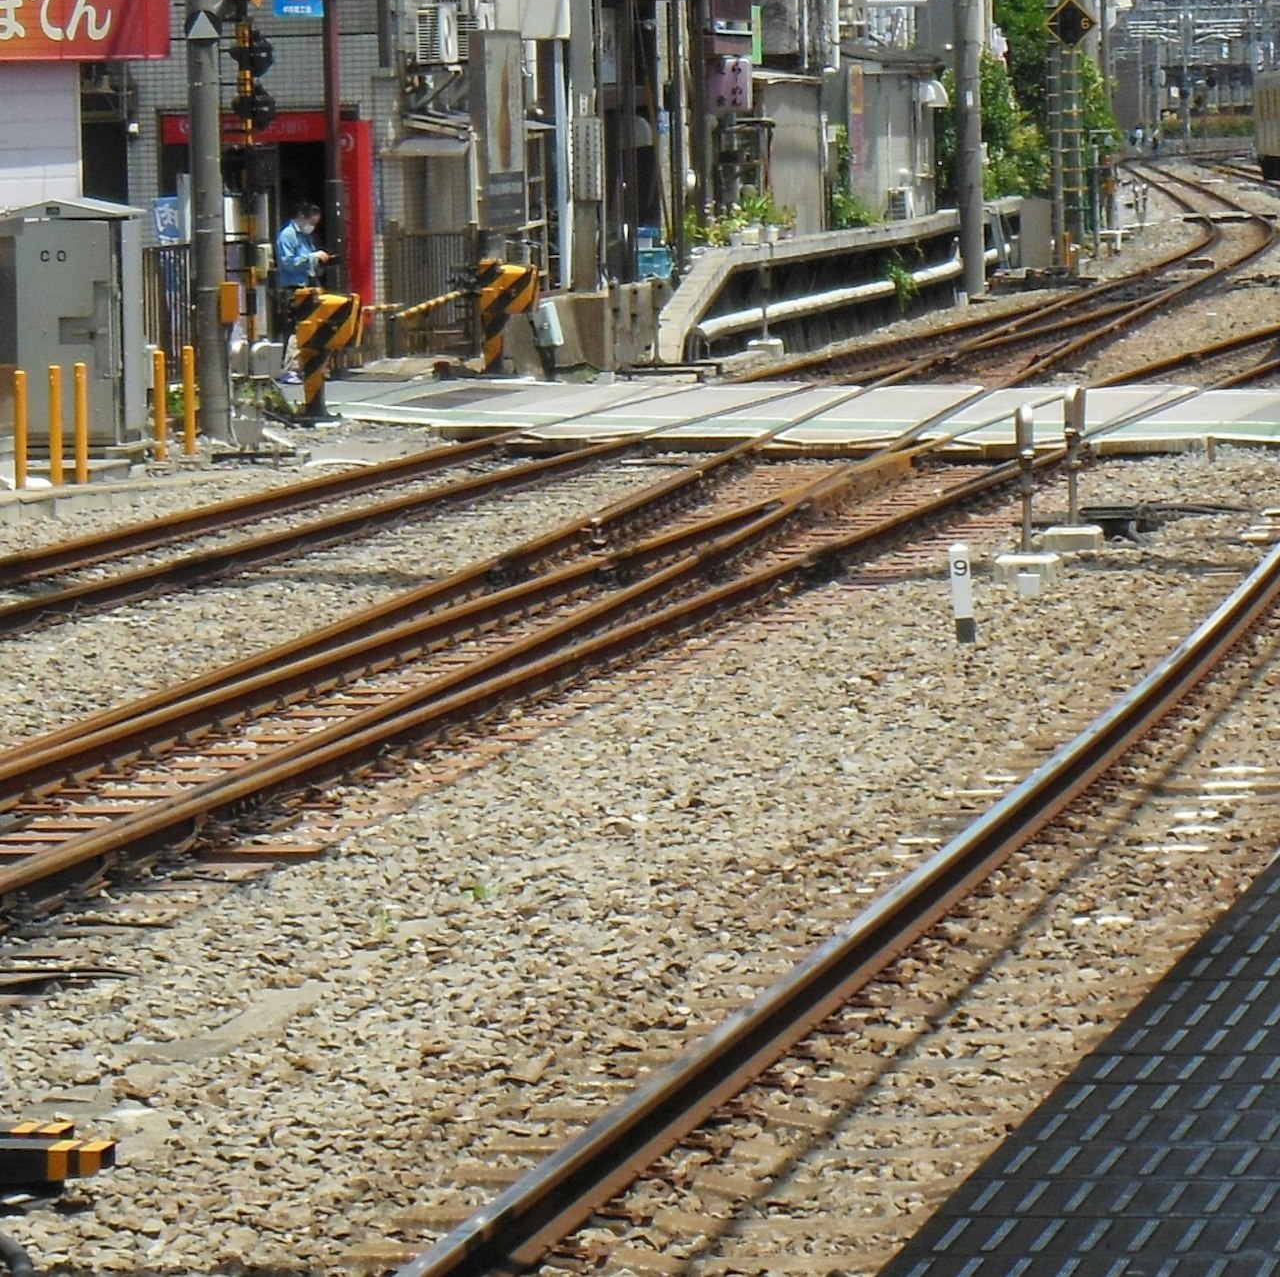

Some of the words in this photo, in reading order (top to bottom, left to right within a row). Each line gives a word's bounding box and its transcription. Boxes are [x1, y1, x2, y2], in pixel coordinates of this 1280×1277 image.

[1081, 18, 1090, 30] 6
[731, 62, 743, 107] らーめん
[953, 559, 968, 576] 9
